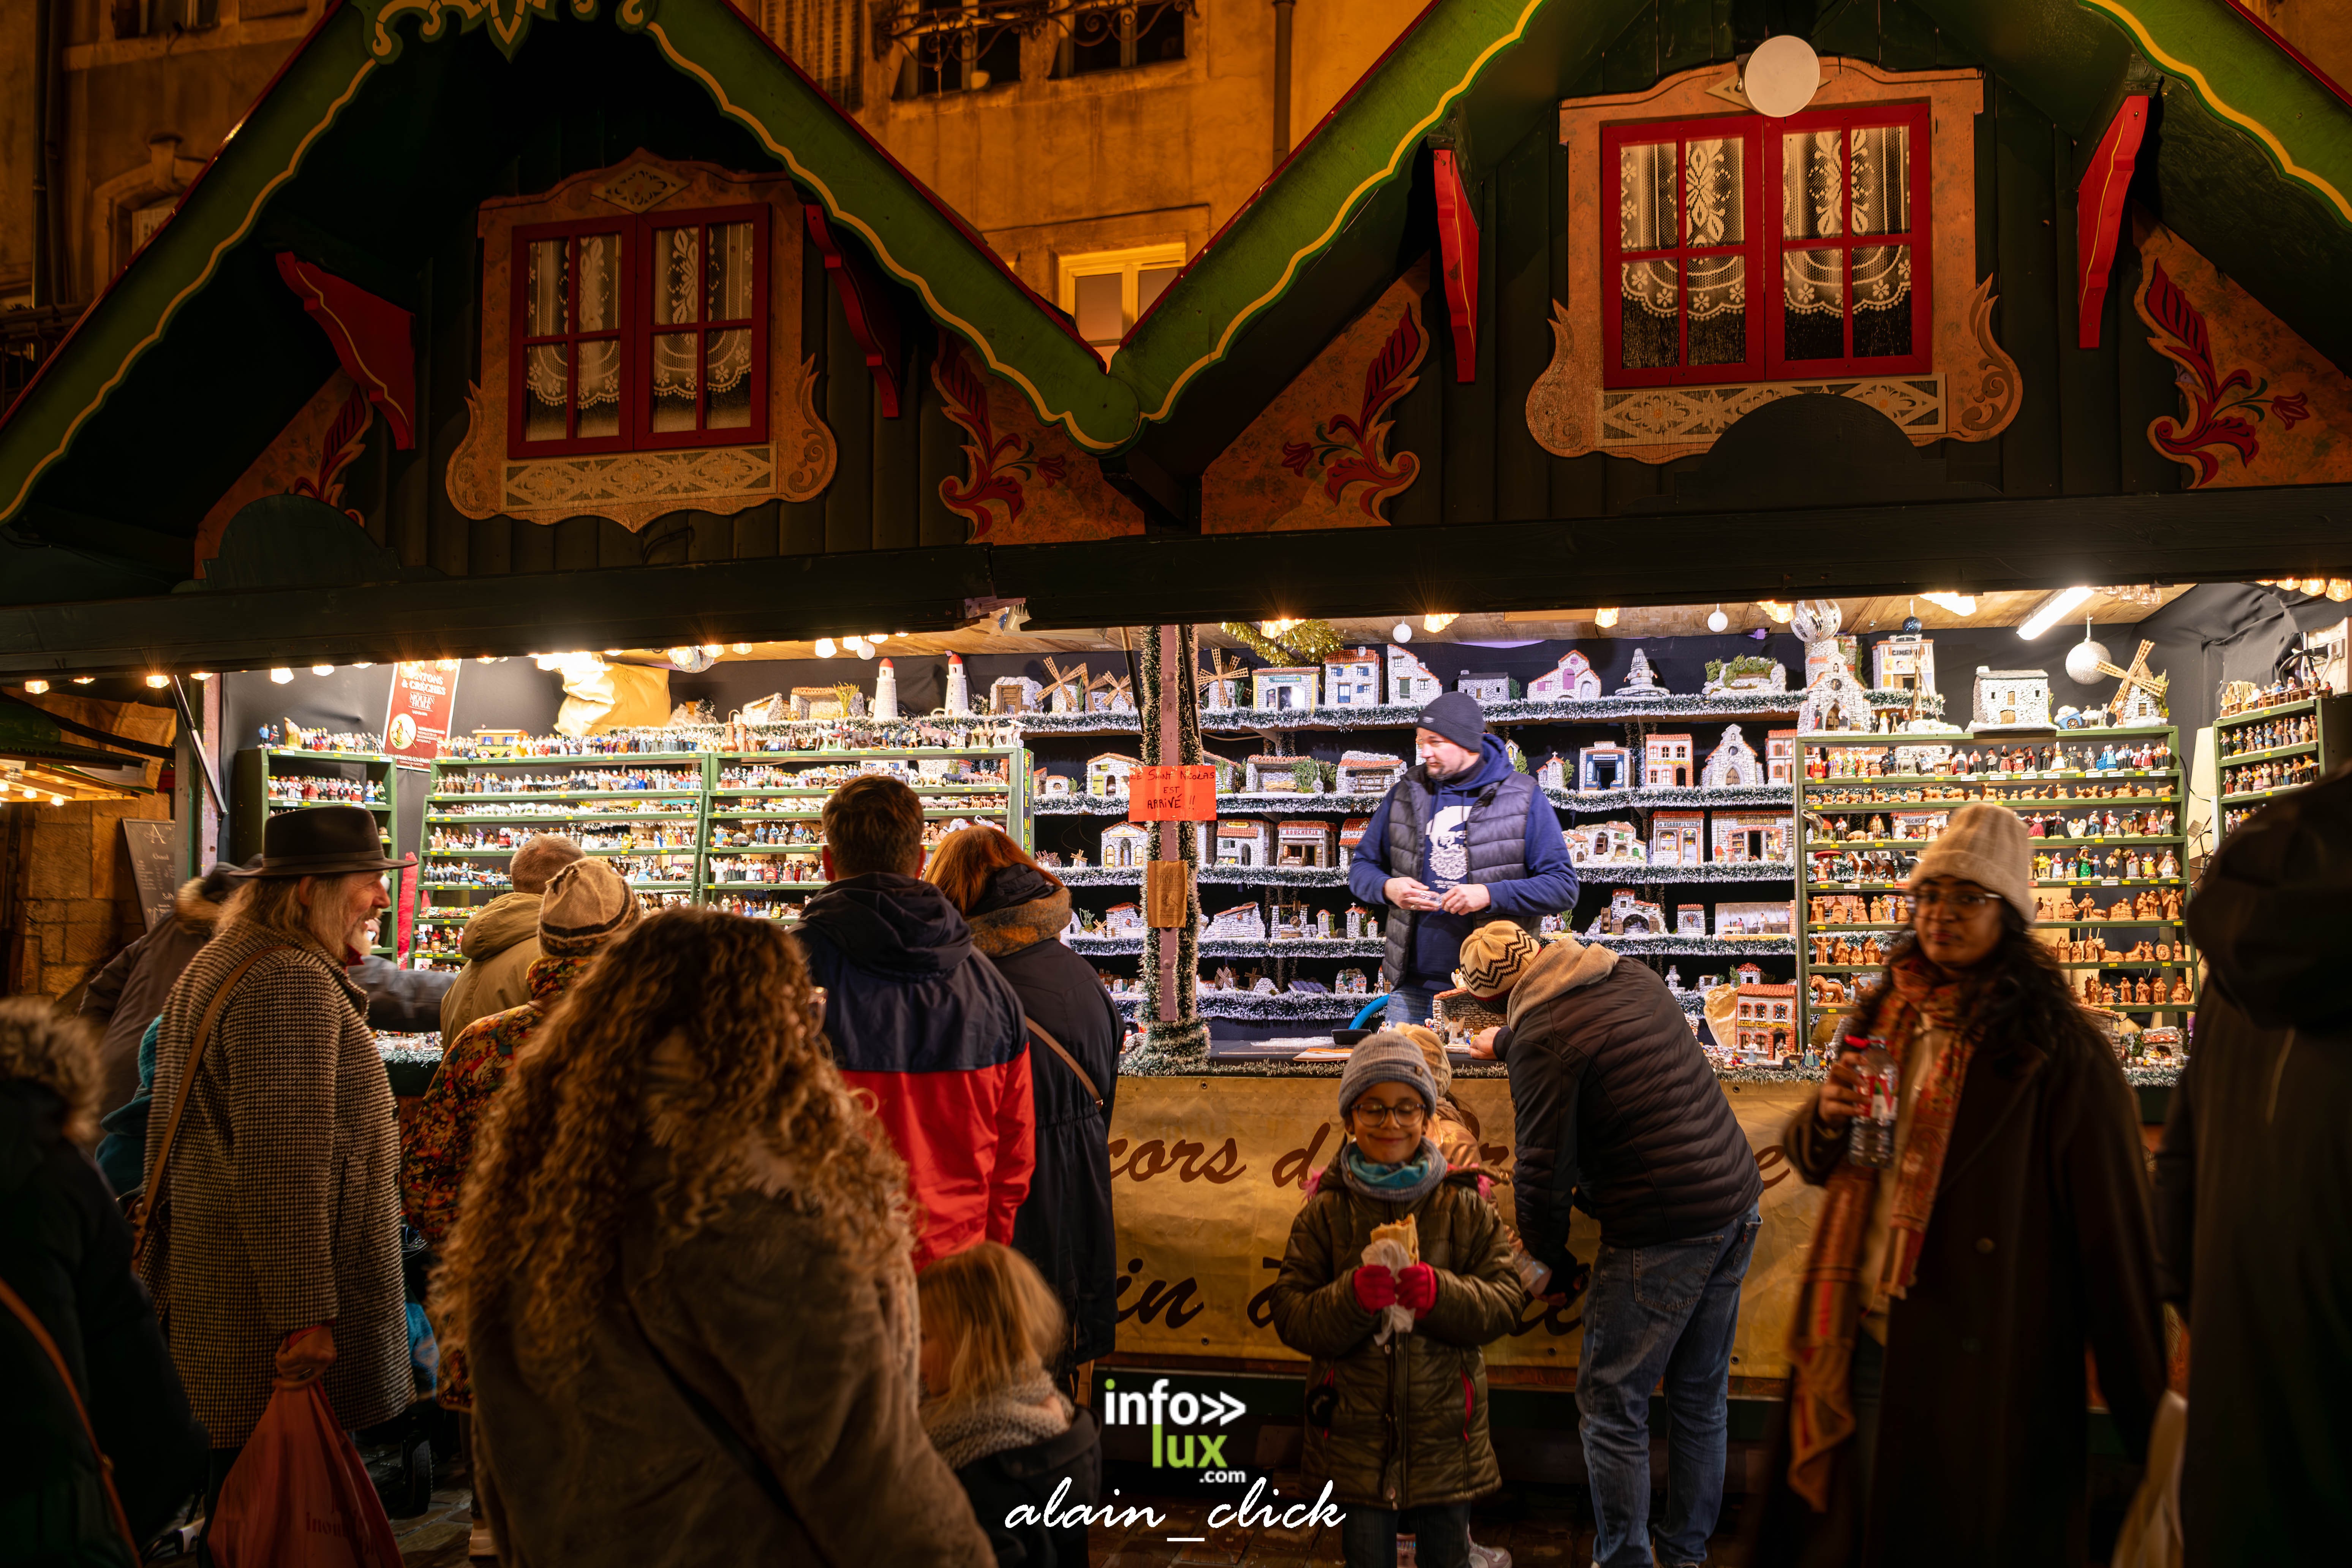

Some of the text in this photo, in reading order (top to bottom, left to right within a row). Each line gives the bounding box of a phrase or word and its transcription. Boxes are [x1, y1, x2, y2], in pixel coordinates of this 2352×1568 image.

[1130, 771, 1142, 780] LE
[1108, 1138, 1247, 1184] cors
[1272, 1122, 1331, 1190] d
[1117, 1258, 1204, 1329] in
